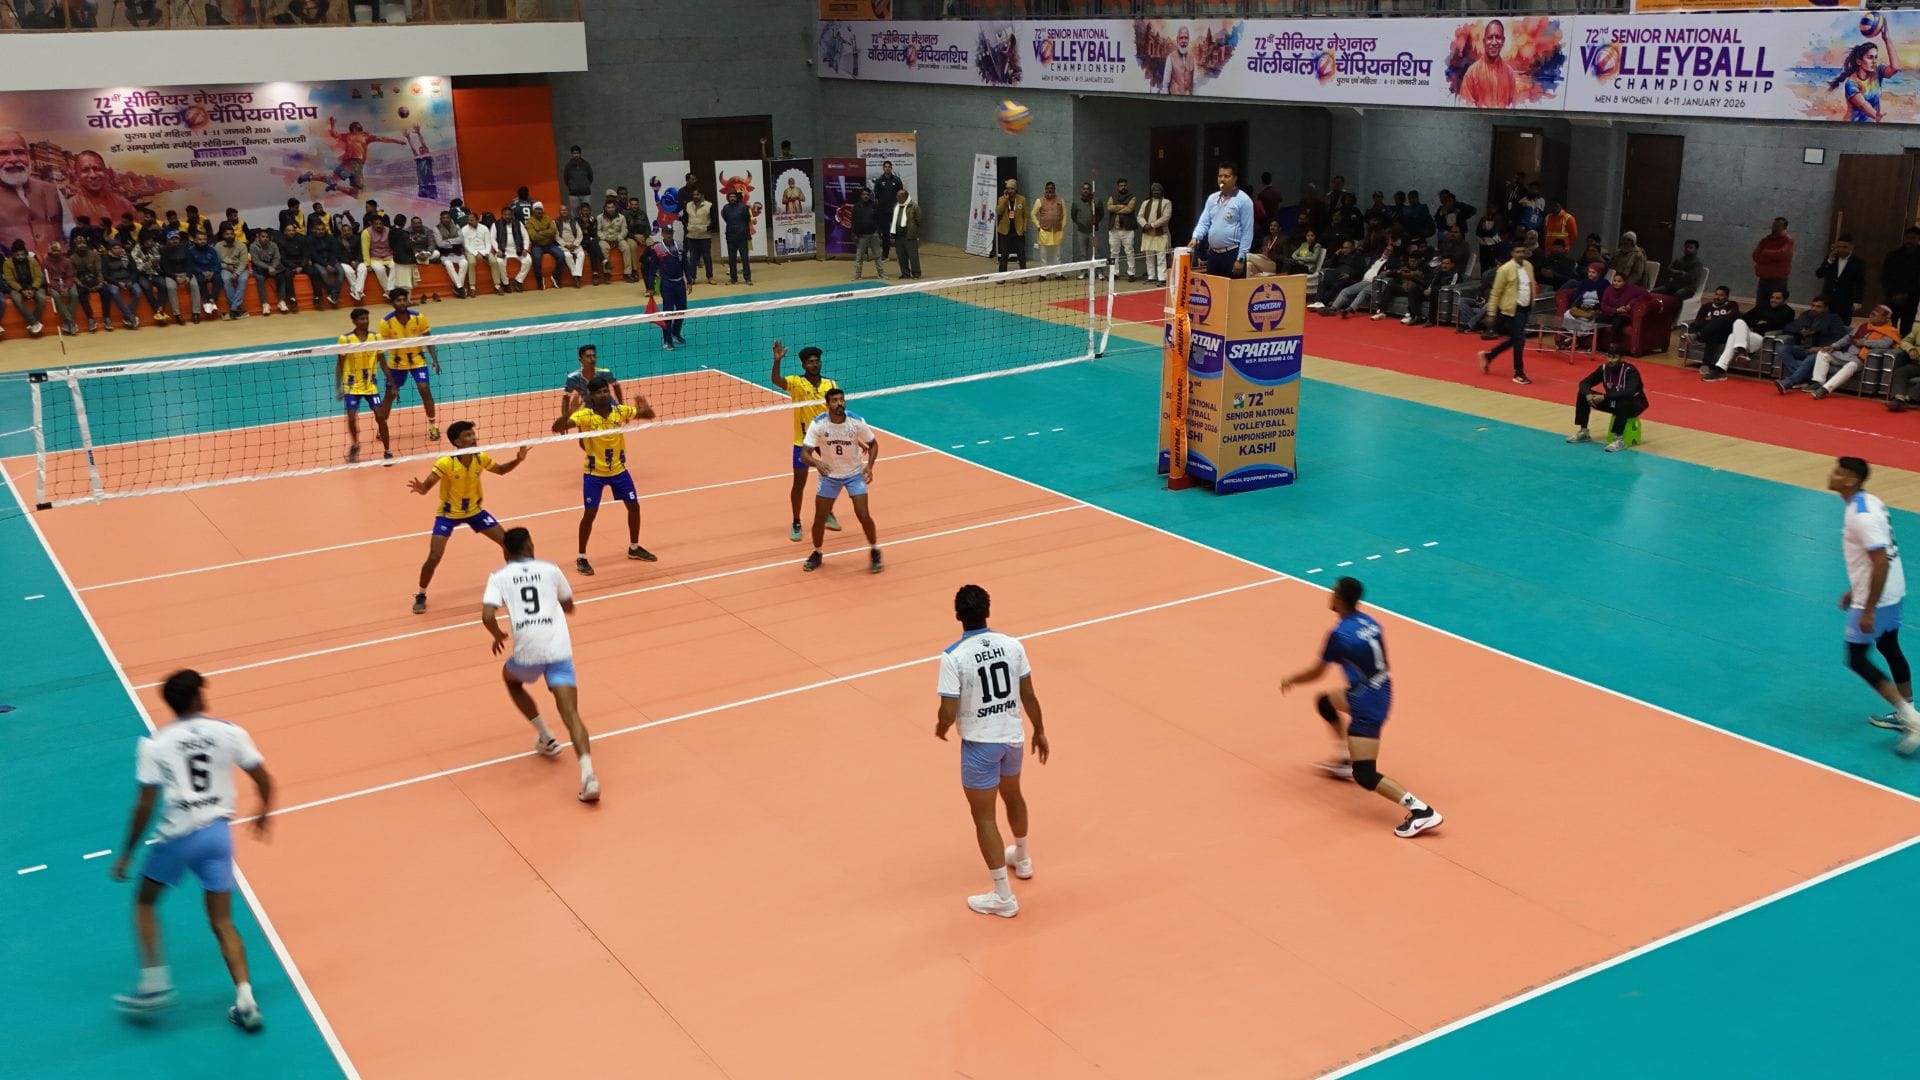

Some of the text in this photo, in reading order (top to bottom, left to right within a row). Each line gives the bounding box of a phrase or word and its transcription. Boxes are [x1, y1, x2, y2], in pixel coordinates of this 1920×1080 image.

[883, 30, 910, 44] सीनियर
[911, 30, 939, 45] नेशनल
[1047, 28, 1071, 40] SENIOR
[1073, 28, 1109, 40] NATIONAL
[1586, 26, 1742, 44] 72nd SENIOR NATIONAL
[1275, 32, 1325, 51] सीनियर
[1326, 32, 1378, 52] नेशनल
[1032, 40, 1126, 64] VOLLEYBALL
[1051, 63, 1126, 73] CHAMPIONSHIP
[1247, 50, 1318, 75] वॉलीबॉल
[1580, 45, 1774, 78] VOLLEYBALL
[1614, 78, 1772, 93] CHAMPIONSHIP
[123, 91, 189, 108] सीनियर
[192, 89, 254, 105] नेशनल
[1595, 95, 1611, 104] MEN
[1621, 95, 1652, 105] WOMEN
[1664, 96, 1680, 105] 4-11
[1681, 97, 1721, 106] JANUARY
[1723, 98, 1746, 108] 2026
[86, 107, 182, 129] वॉलीबॉल
[164, 129, 191, 138] महिला
[223, 157, 258, 166] वाराणसी
[522, 207, 530, 219] 9
[1253, 302, 1282, 311] SPARTAN
[1229, 340, 1298, 359] SPARTAN
[373, 396, 381, 404] 11
[1248, 389, 1274, 407] 72nd
[1226, 407, 1294, 421] SENIOR NATIONAL
[1233, 418, 1286, 431] VOLLEYBALL
[1222, 429, 1295, 444] CHAMPIONSHIP 2026
[835, 446, 843, 456] 8
[1239, 442, 1276, 456] KASHI
[629, 491, 635, 500] 5
[512, 573, 541, 585] DELHI
[520, 586, 540, 615] 9
[974, 647, 1005, 663] DELHI
[977, 660, 1011, 703] 10
[977, 700, 1016, 718] SPARTAN
[188, 753, 212, 792] 6
